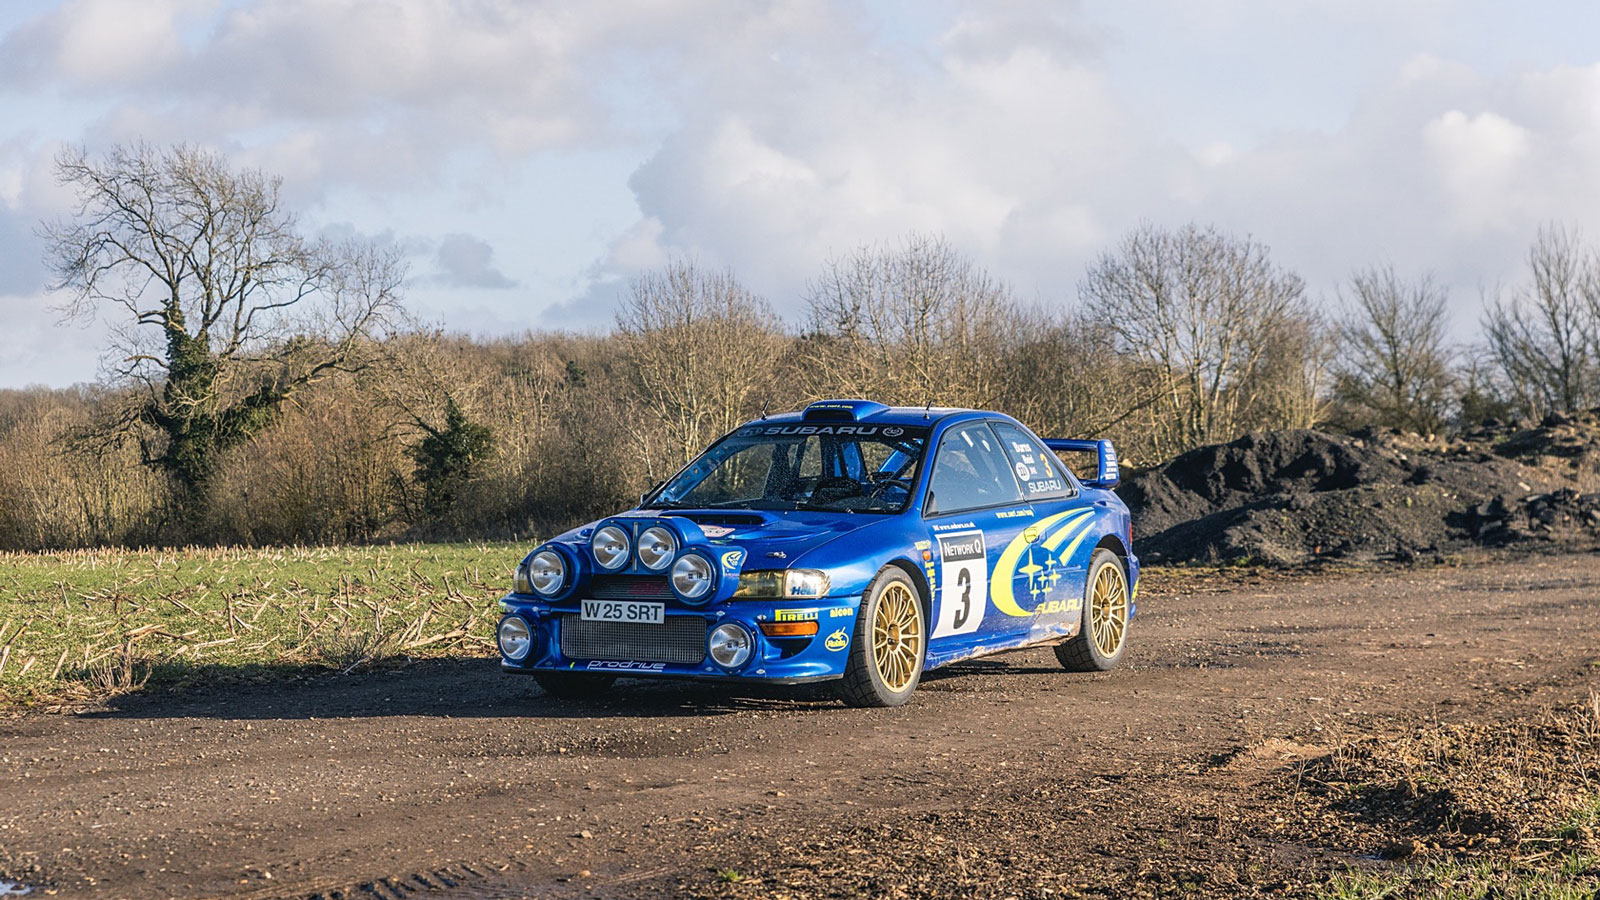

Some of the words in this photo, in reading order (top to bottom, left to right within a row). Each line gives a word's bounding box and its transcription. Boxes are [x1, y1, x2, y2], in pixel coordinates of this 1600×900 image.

[764, 426, 878, 436] SUBARU
[1040, 453, 1053, 478] 3
[1028, 480, 1061, 493] SUBARU
[943, 542, 975, 557] NETWORK
[974, 539, 982, 554] Q
[953, 567, 971, 630] 3
[584, 602, 601, 618] W
[603, 603, 623, 619] 25
[626, 604, 662, 621] SRT
[829, 607, 854, 618] alcon
[1035, 598, 1084, 615] SUBARU
[775, 608, 819, 621] PIRELLI
[586, 660, 666, 671] prodrive
